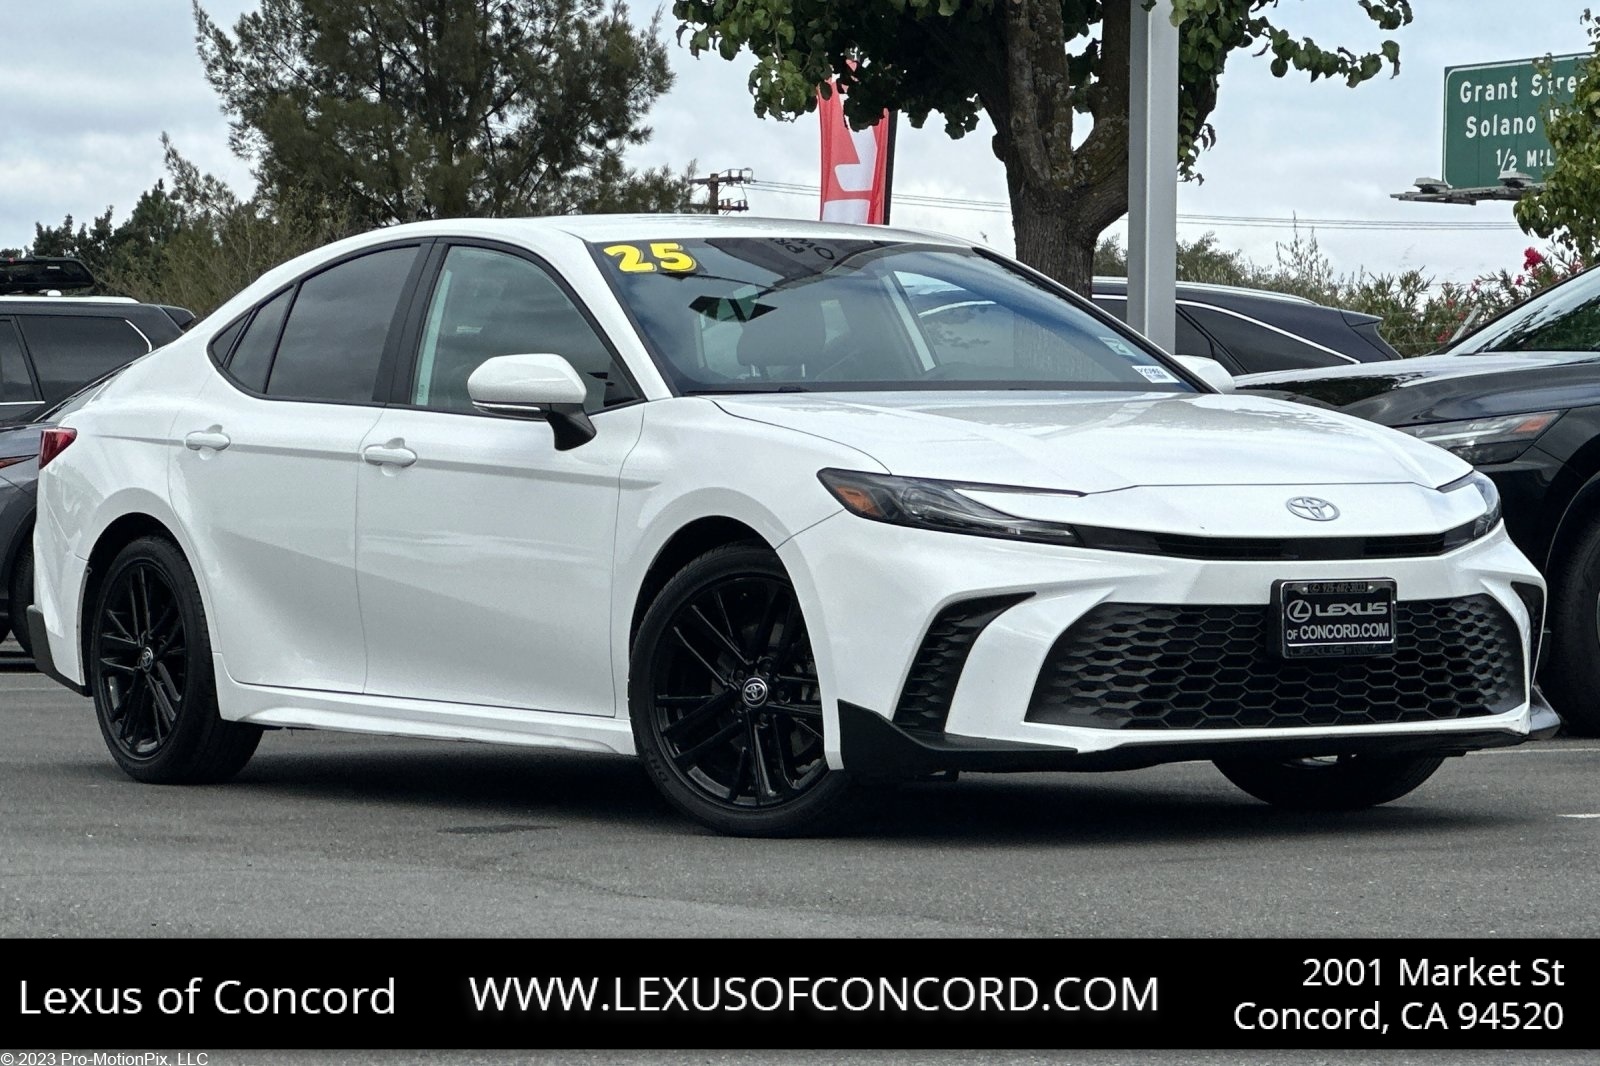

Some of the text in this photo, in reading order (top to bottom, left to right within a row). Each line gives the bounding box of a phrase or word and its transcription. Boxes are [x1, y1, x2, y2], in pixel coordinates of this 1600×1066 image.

[1460, 76, 1518, 103] Grant
[1465, 114, 1536, 139] Solano
[1526, 148, 1555, 168] MIL
[603, 242, 697, 273] 25
[1315, 602, 1388, 616] LEXUS
[1286, 623, 1390, 640] OF CONCORD.COM
